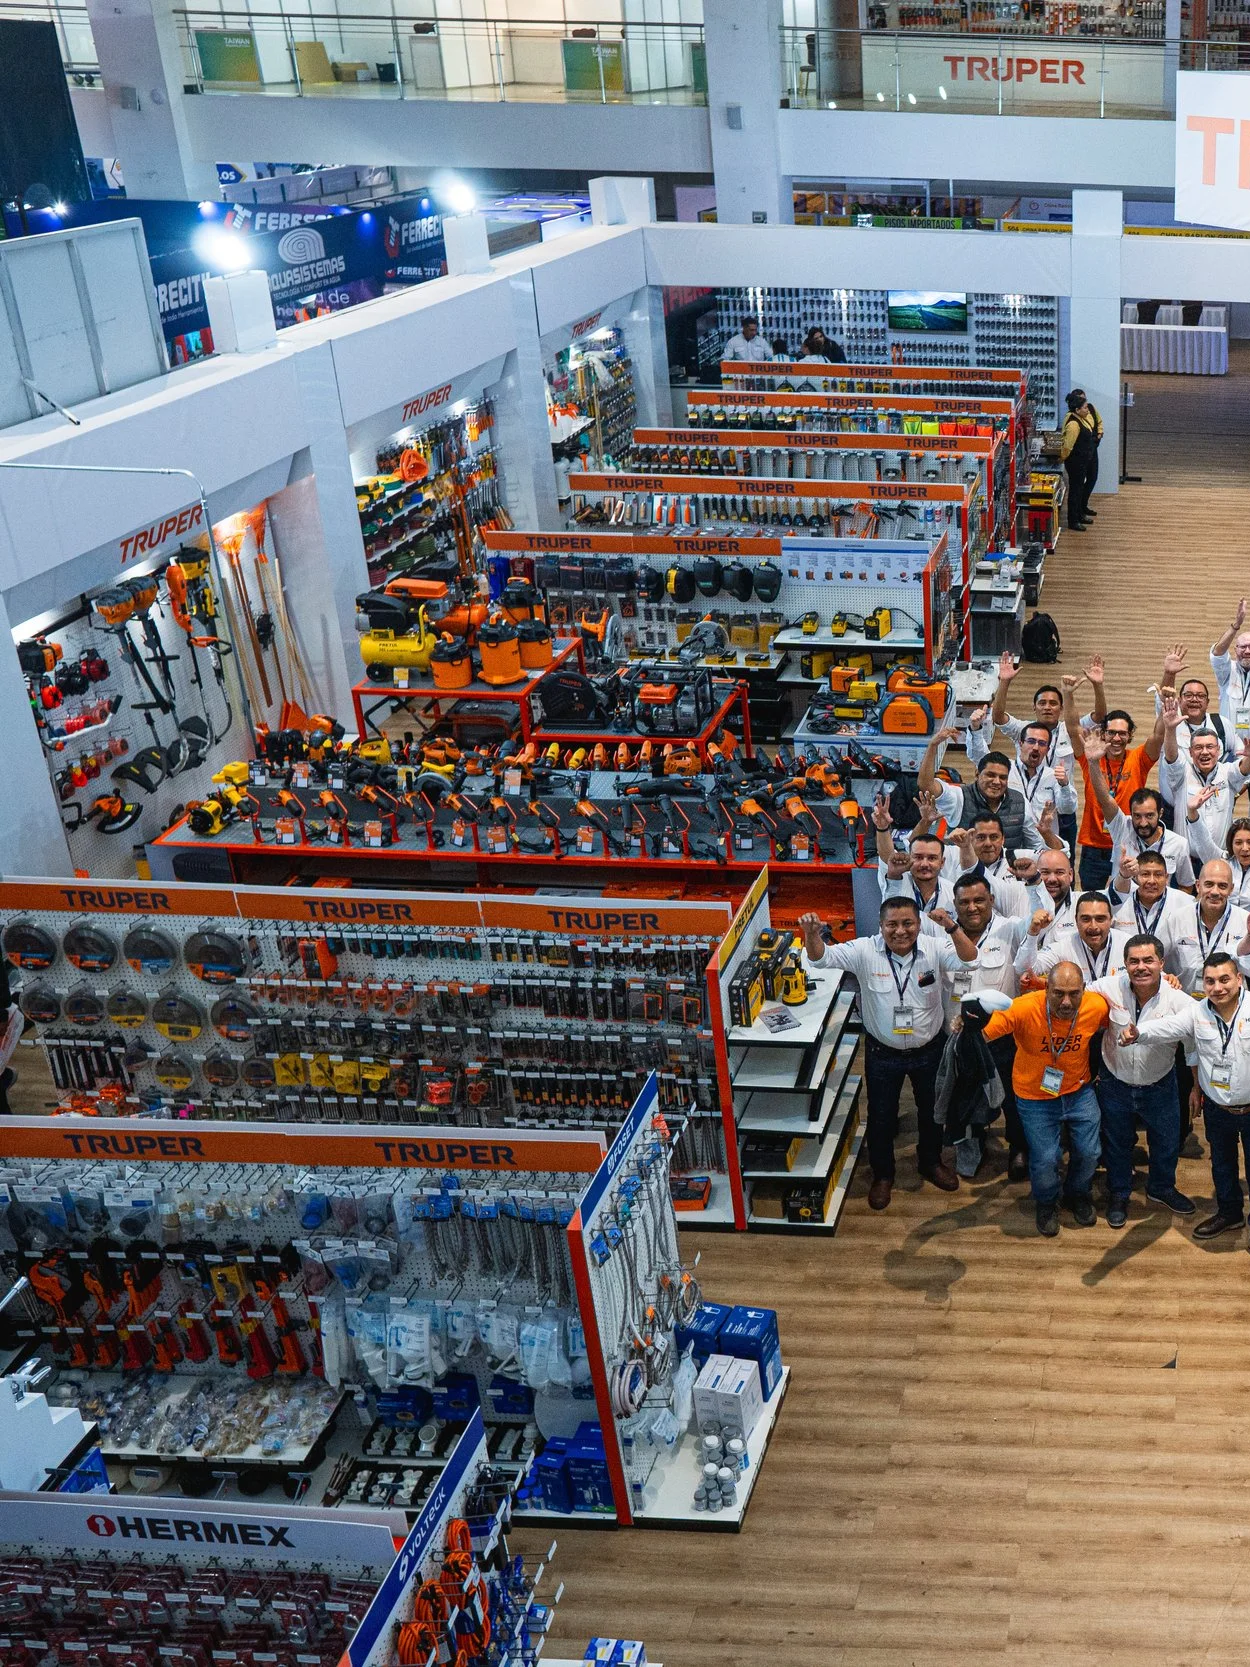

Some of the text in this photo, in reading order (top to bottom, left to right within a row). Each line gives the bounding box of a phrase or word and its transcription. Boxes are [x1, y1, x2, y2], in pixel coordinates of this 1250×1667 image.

[223, 37, 251, 46] TAIWAN
[943, 55, 1085, 85] TRUPER
[402, 214, 442, 245] FERRECI
[884, 218, 956, 230] PISOS IMPORTADOS
[571, 313, 602, 338] TRUPER
[748, 363, 793, 374] TRUPER
[848, 367, 893, 377] TRUPER
[949, 370, 993, 380] TRUPER
[401, 384, 452, 422] TRUPER
[717, 394, 765, 405] TRUPER
[825, 397, 873, 408] TRUPER
[933, 401, 981, 411] TRUPER
[666, 432, 719, 444] TRUPER
[785, 435, 838, 446] TRUPER
[904, 438, 958, 449] TRUPER
[605, 477, 664, 489] TRUPER
[736, 481, 795, 494] TRUPER
[868, 485, 927, 498] TRUPER
[119, 503, 206, 563] TRUPER
[526, 536, 592, 549] TRUPER
[674, 539, 740, 553] TRUPER
[60, 889, 171, 909] TRUPER
[303, 901, 412, 920] TRUPER
[734, 895, 755, 938] PRETUL
[548, 910, 660, 931] TRUPER
[64, 1134, 205, 1156] TRUPER
[613, 1117, 636, 1167] FOSET
[374, 1142, 517, 1165] TRUPER
[407, 1486, 446, 1556] VOLTECK
[117, 1515, 297, 1548] HERMEX
